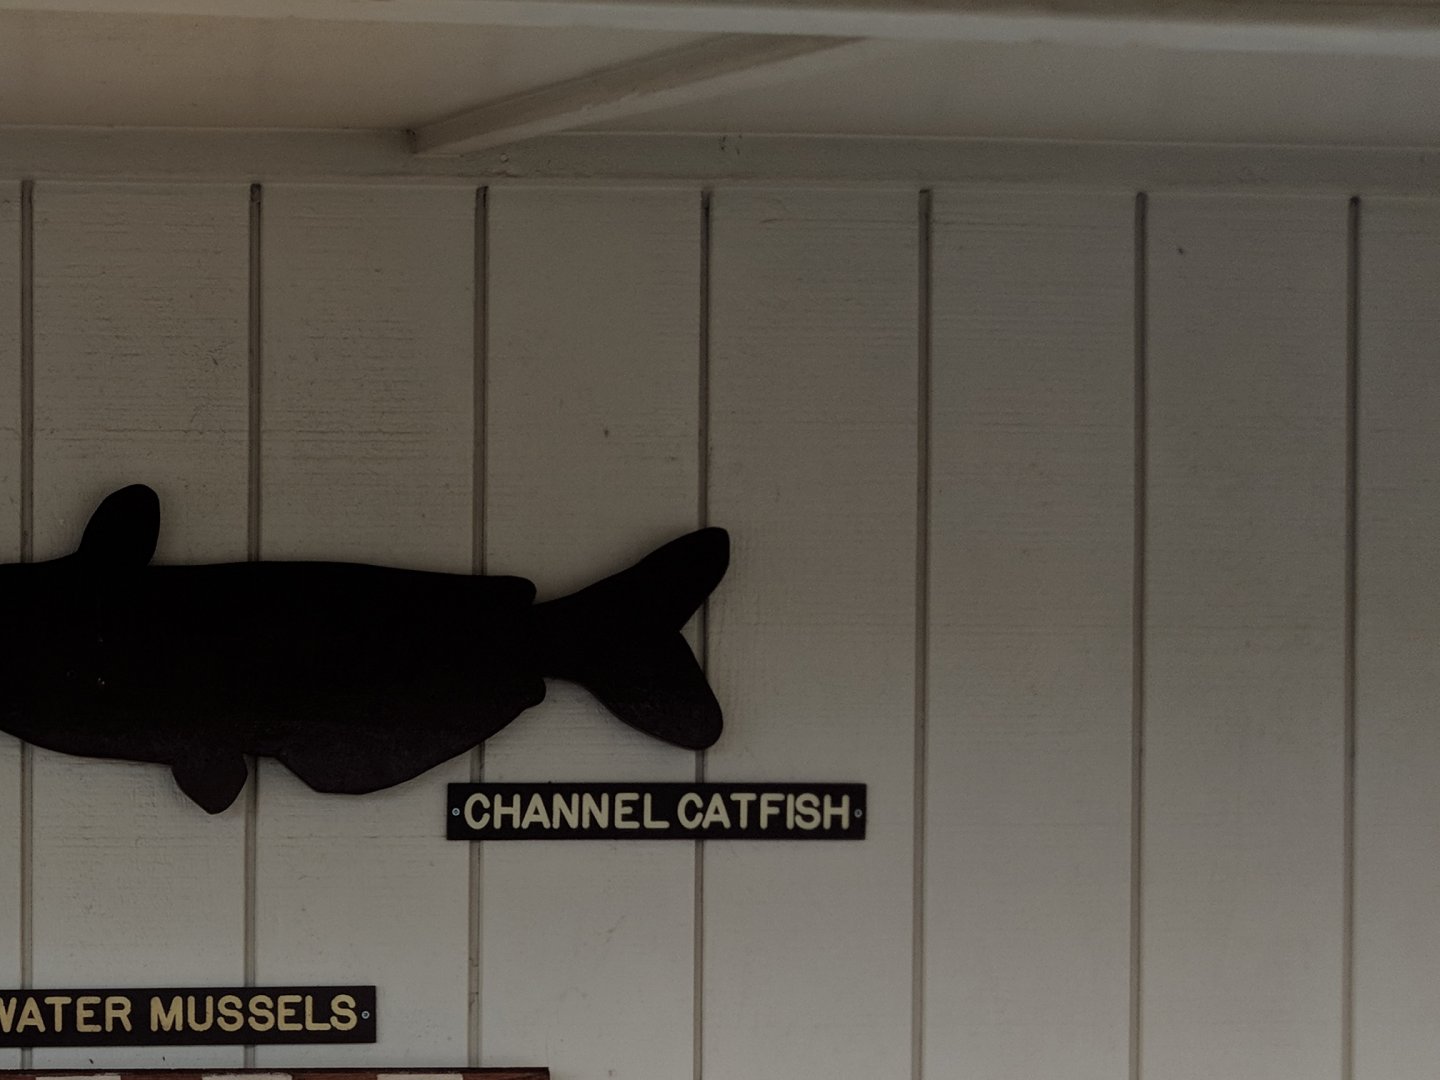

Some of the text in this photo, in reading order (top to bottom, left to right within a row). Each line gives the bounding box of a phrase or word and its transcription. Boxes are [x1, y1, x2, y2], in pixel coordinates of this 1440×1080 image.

[463, 792, 850, 830] CHANNEL CATFISH
[150, 994, 358, 1032] MUSSELS
